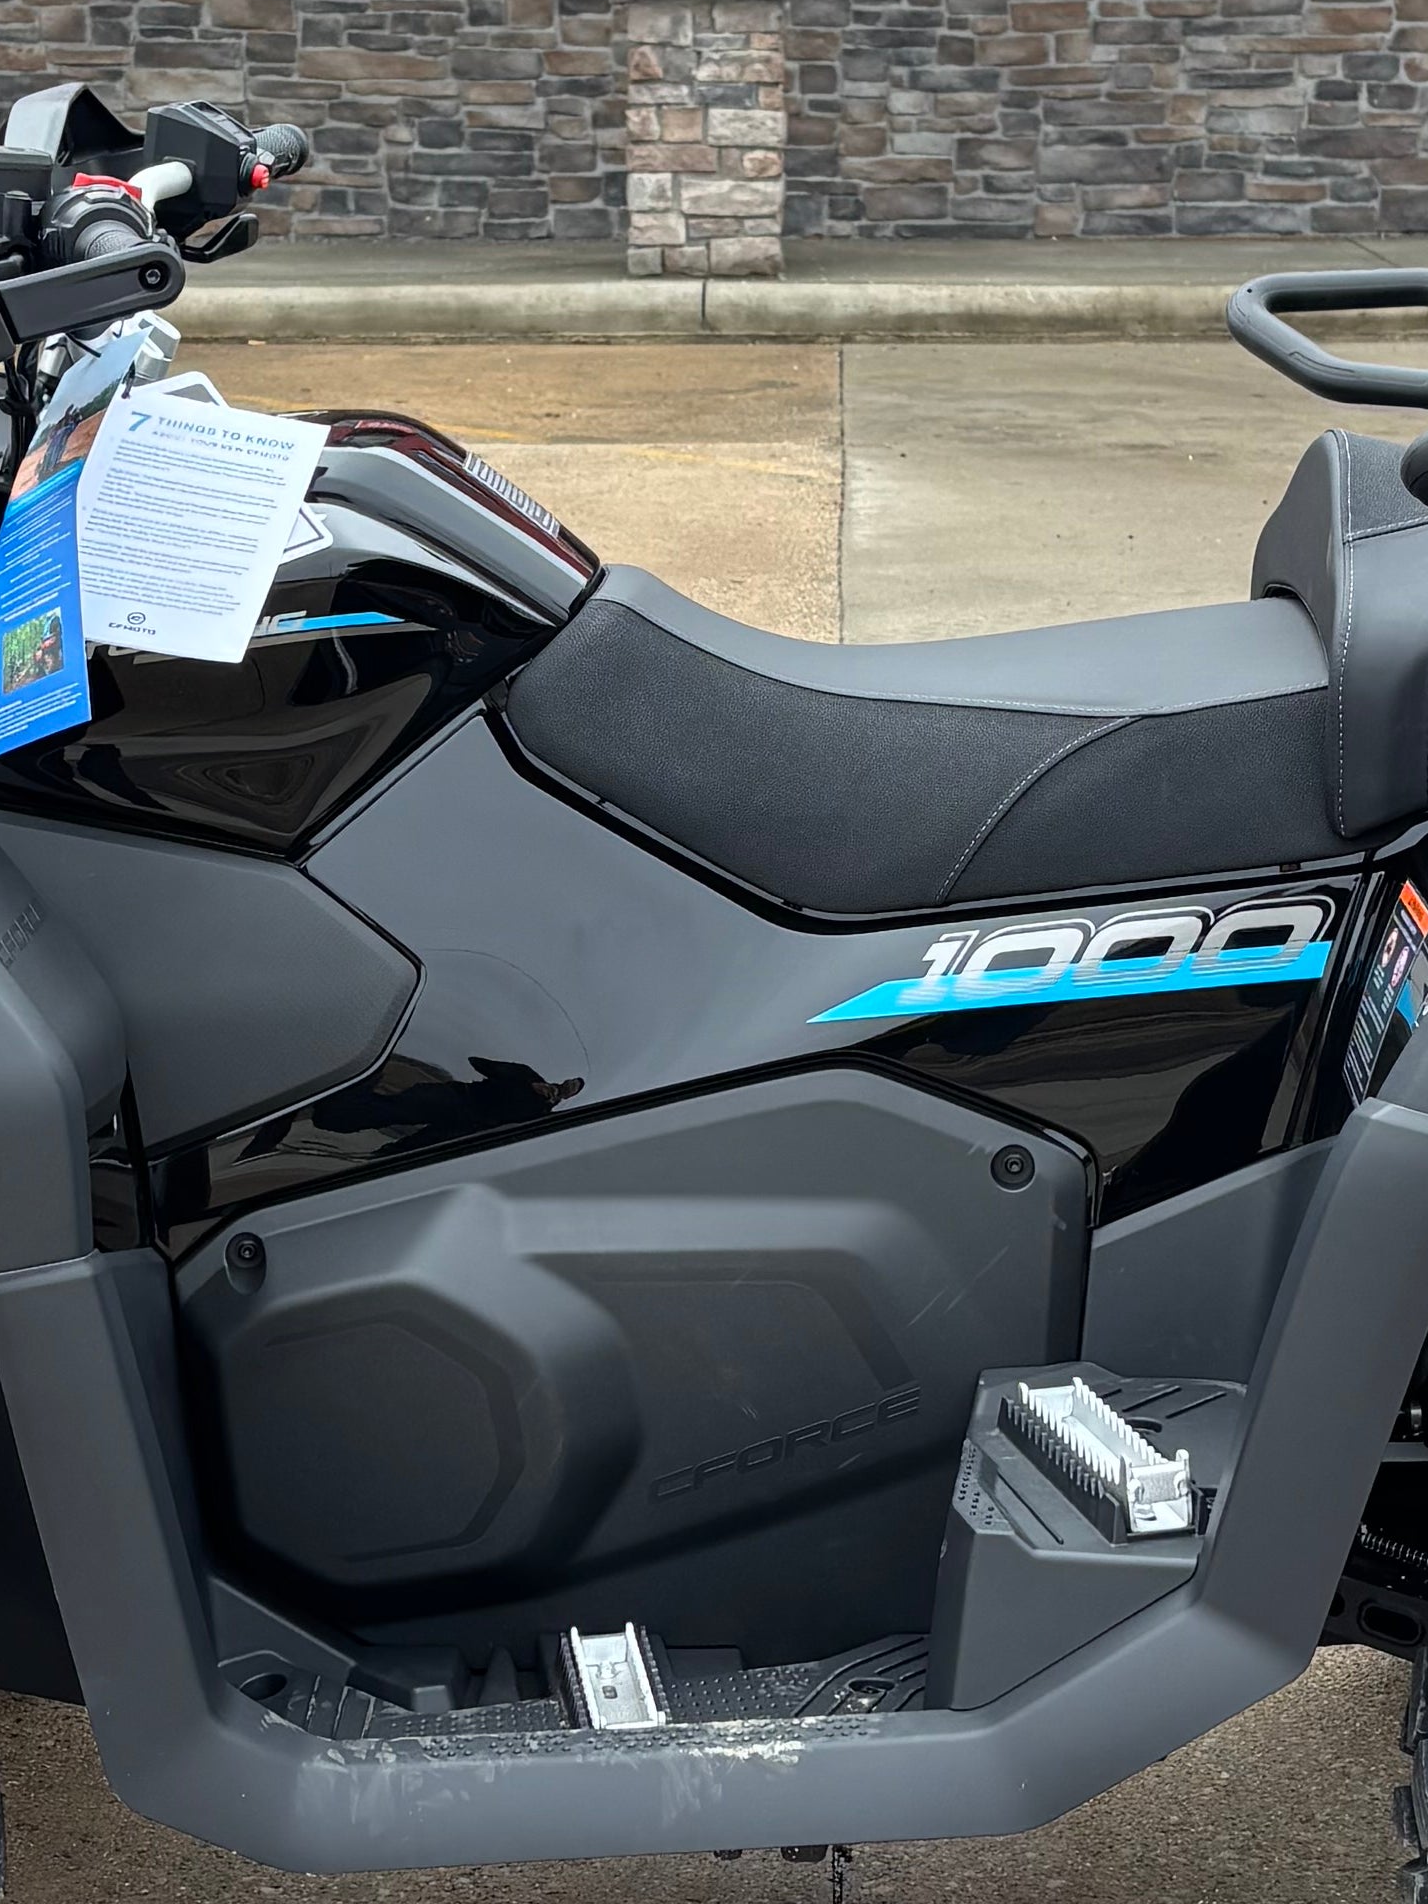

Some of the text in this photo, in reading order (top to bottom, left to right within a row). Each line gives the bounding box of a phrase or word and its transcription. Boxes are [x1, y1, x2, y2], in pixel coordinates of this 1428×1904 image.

[128, 411, 152, 432] 7
[222, 429, 241, 441] TO
[245, 435, 295, 450] KNOW
[108, 622, 156, 636] CFMOTO
[910, 895, 1336, 1000] 1000
[651, 1384, 921, 1501] CFORCE
